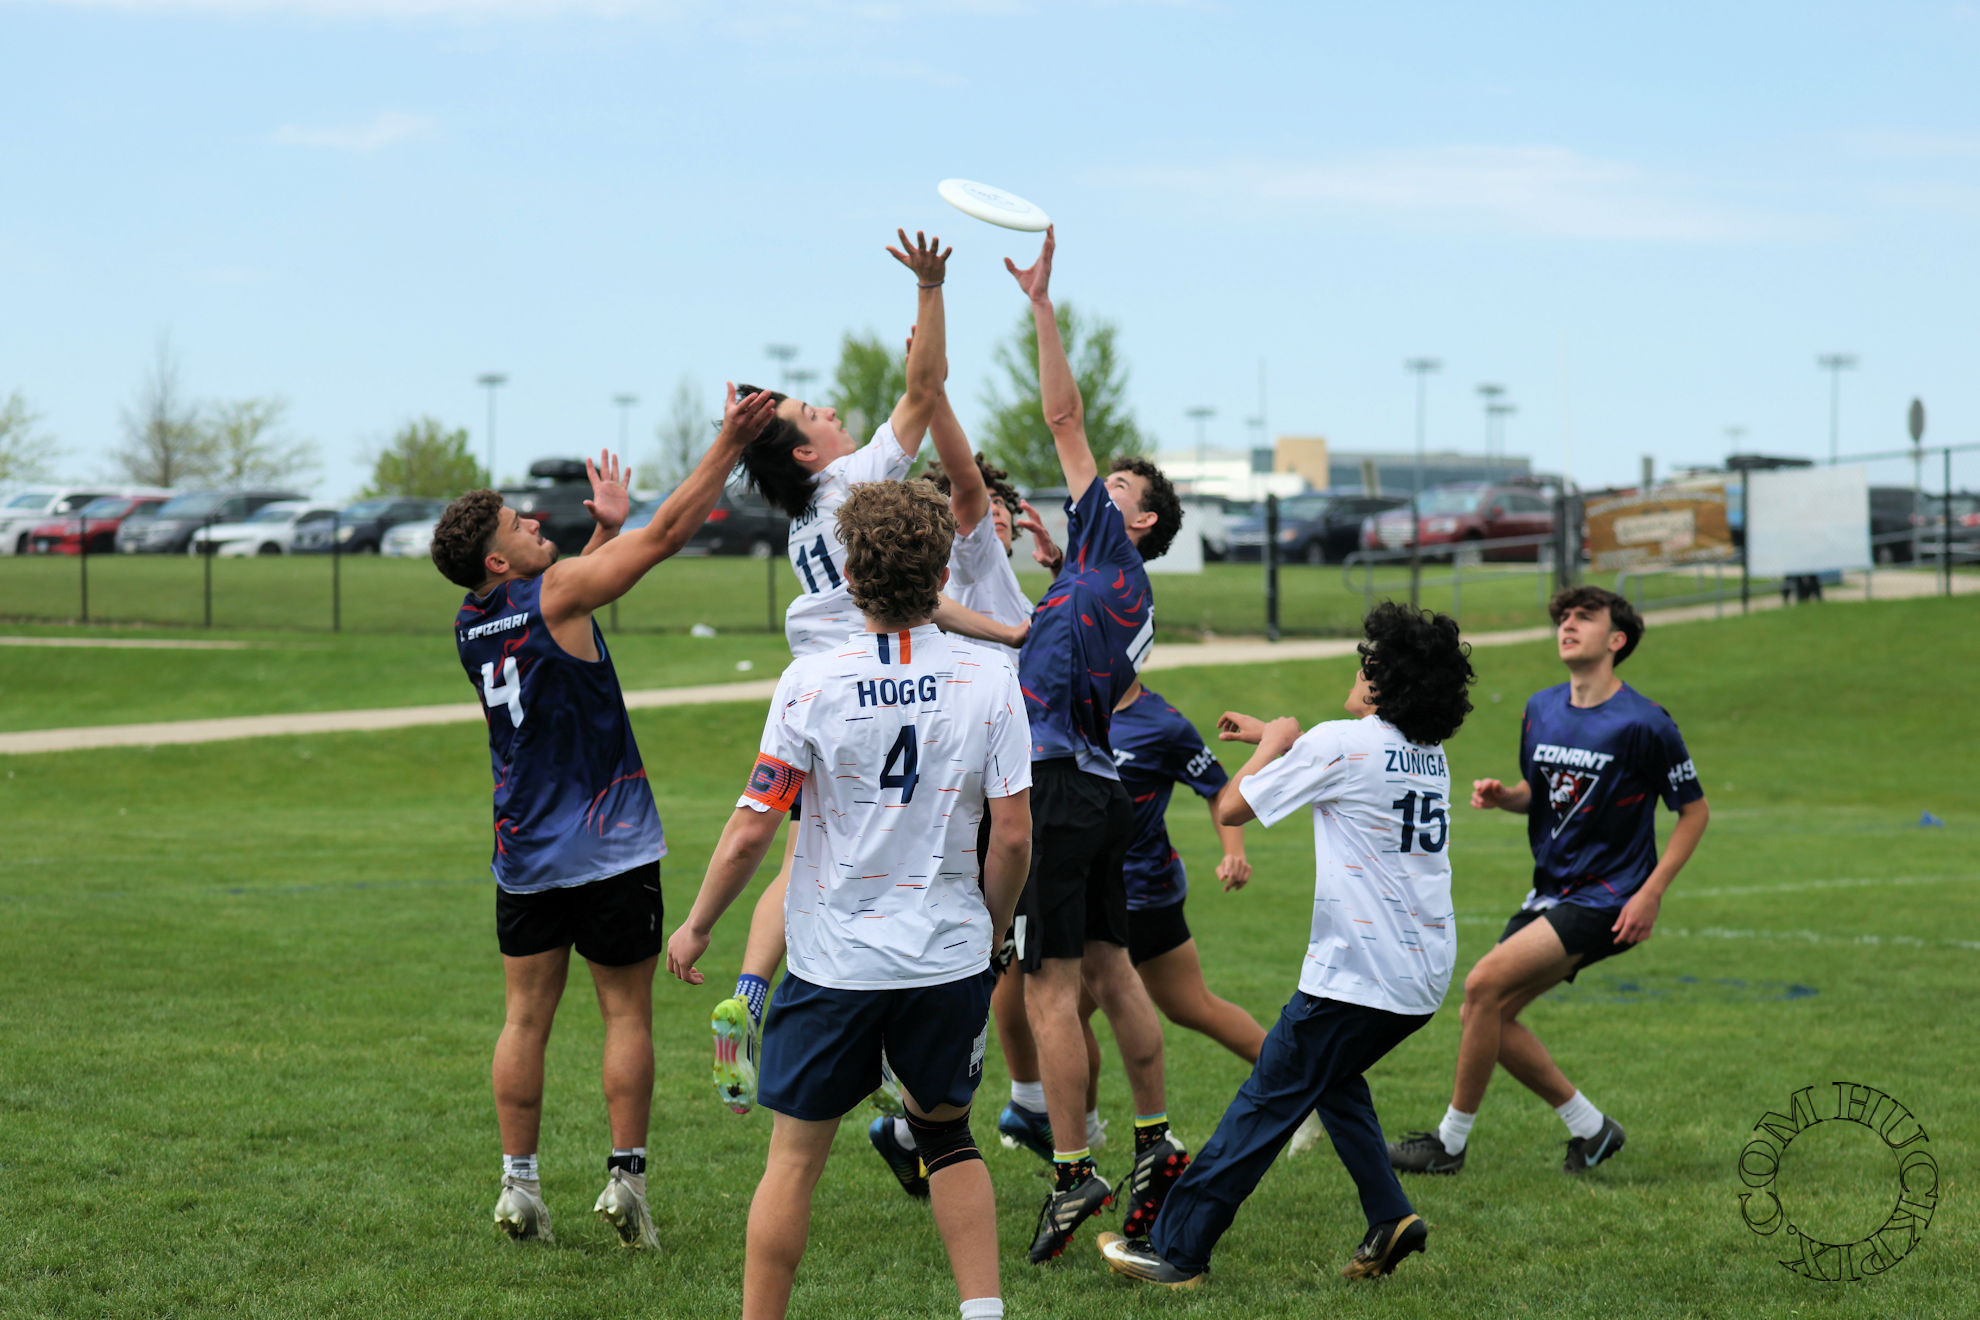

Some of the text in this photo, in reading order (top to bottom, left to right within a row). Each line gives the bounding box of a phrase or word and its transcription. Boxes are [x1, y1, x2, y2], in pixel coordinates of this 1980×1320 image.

[796, 533, 842, 594] 11
[481, 656, 524, 729] 4
[857, 675, 937, 708] HOGG
[880, 725, 920, 804] 4
[1384, 746, 1447, 778] ZÚÑIGA
[1532, 743, 1615, 771] CONANT
[1392, 790, 1448, 853] 15
